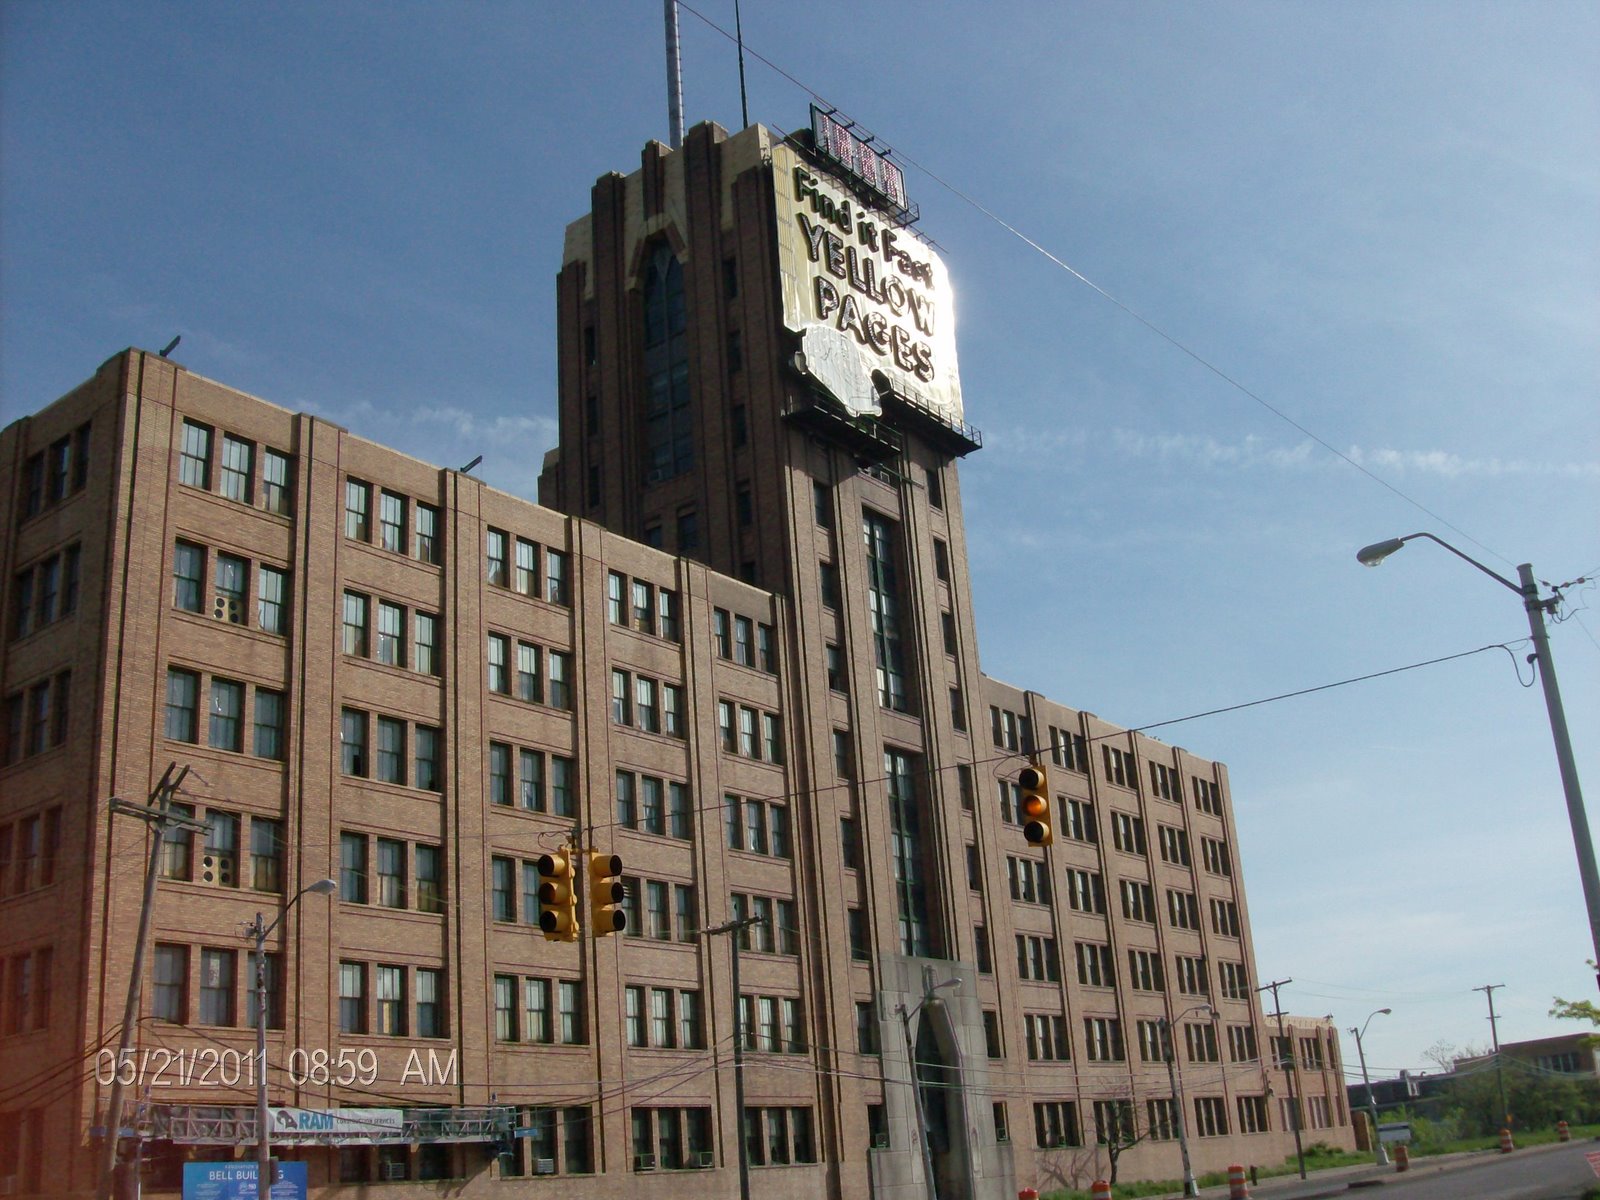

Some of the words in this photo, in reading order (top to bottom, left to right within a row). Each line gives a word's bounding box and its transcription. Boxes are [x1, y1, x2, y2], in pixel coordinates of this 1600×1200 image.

[792, 167, 853, 235] Find
[856, 211, 879, 253] it
[795, 212, 935, 337] YELLOW
[813, 276, 935, 383] PAGES
[298, 1112, 334, 1130] RAM
[209, 1170, 233, 1181] BELL
[236, 1169, 285, 1180] BUILG
